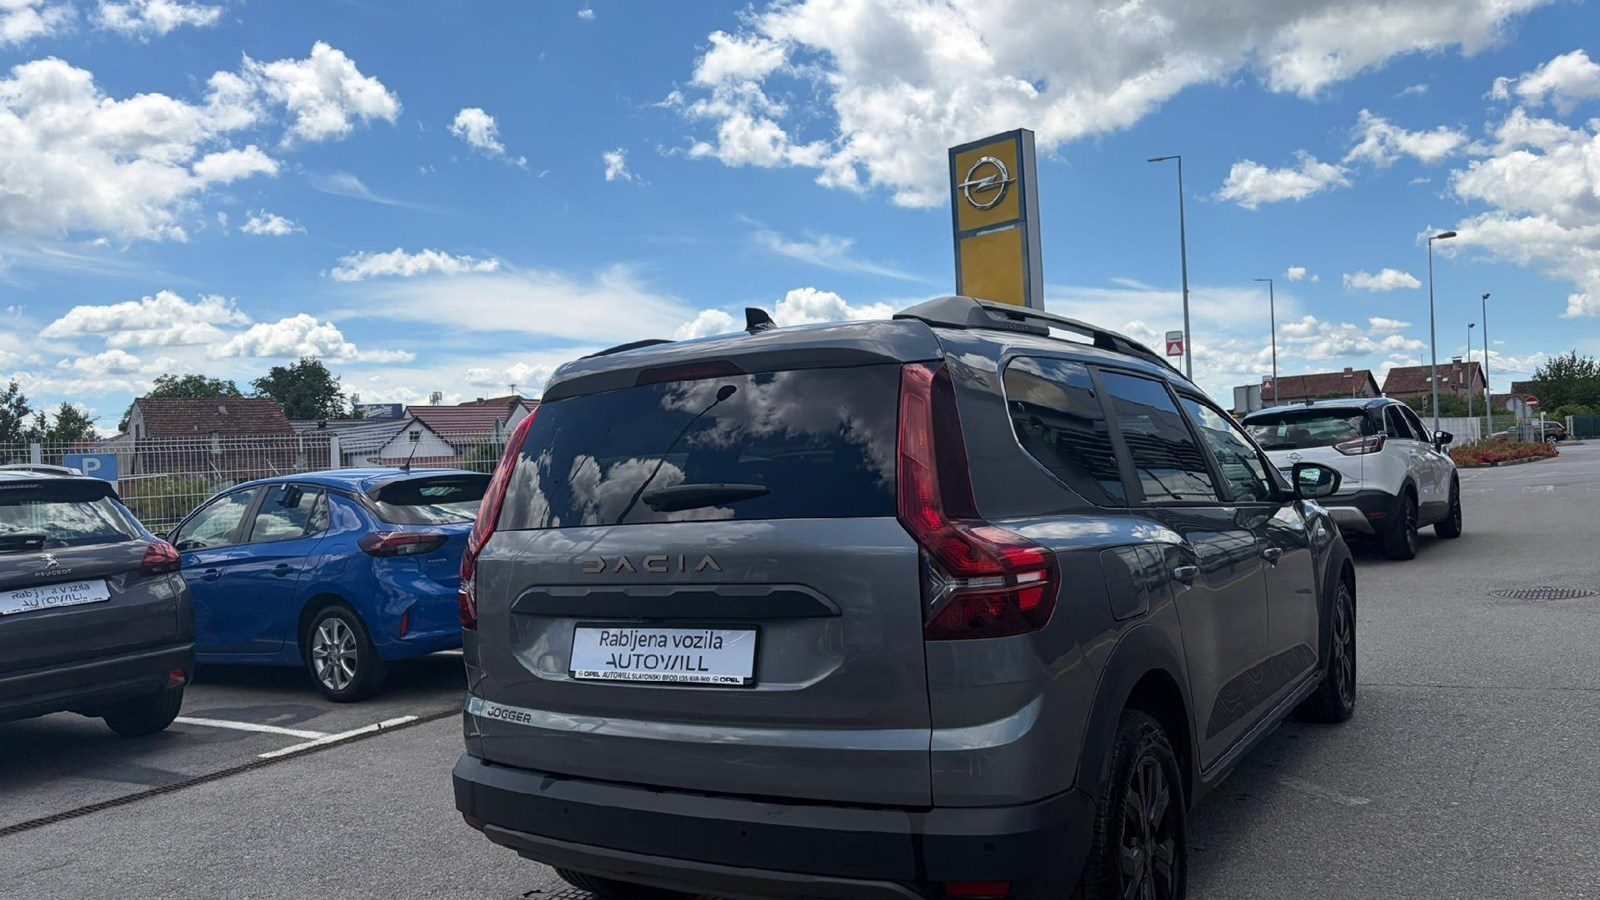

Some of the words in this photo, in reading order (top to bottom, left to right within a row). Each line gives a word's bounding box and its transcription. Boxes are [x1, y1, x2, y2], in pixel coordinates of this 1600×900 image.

[82, 457, 101, 476] P
[34, 568, 72, 577] PEUGEOT
[582, 554, 723, 575] DACIA
[599, 630, 667, 651] Rabljena
[672, 630, 723, 650] vozila
[605, 653, 709, 671] AUTOWILL
[487, 706, 531, 723] JOGGER
